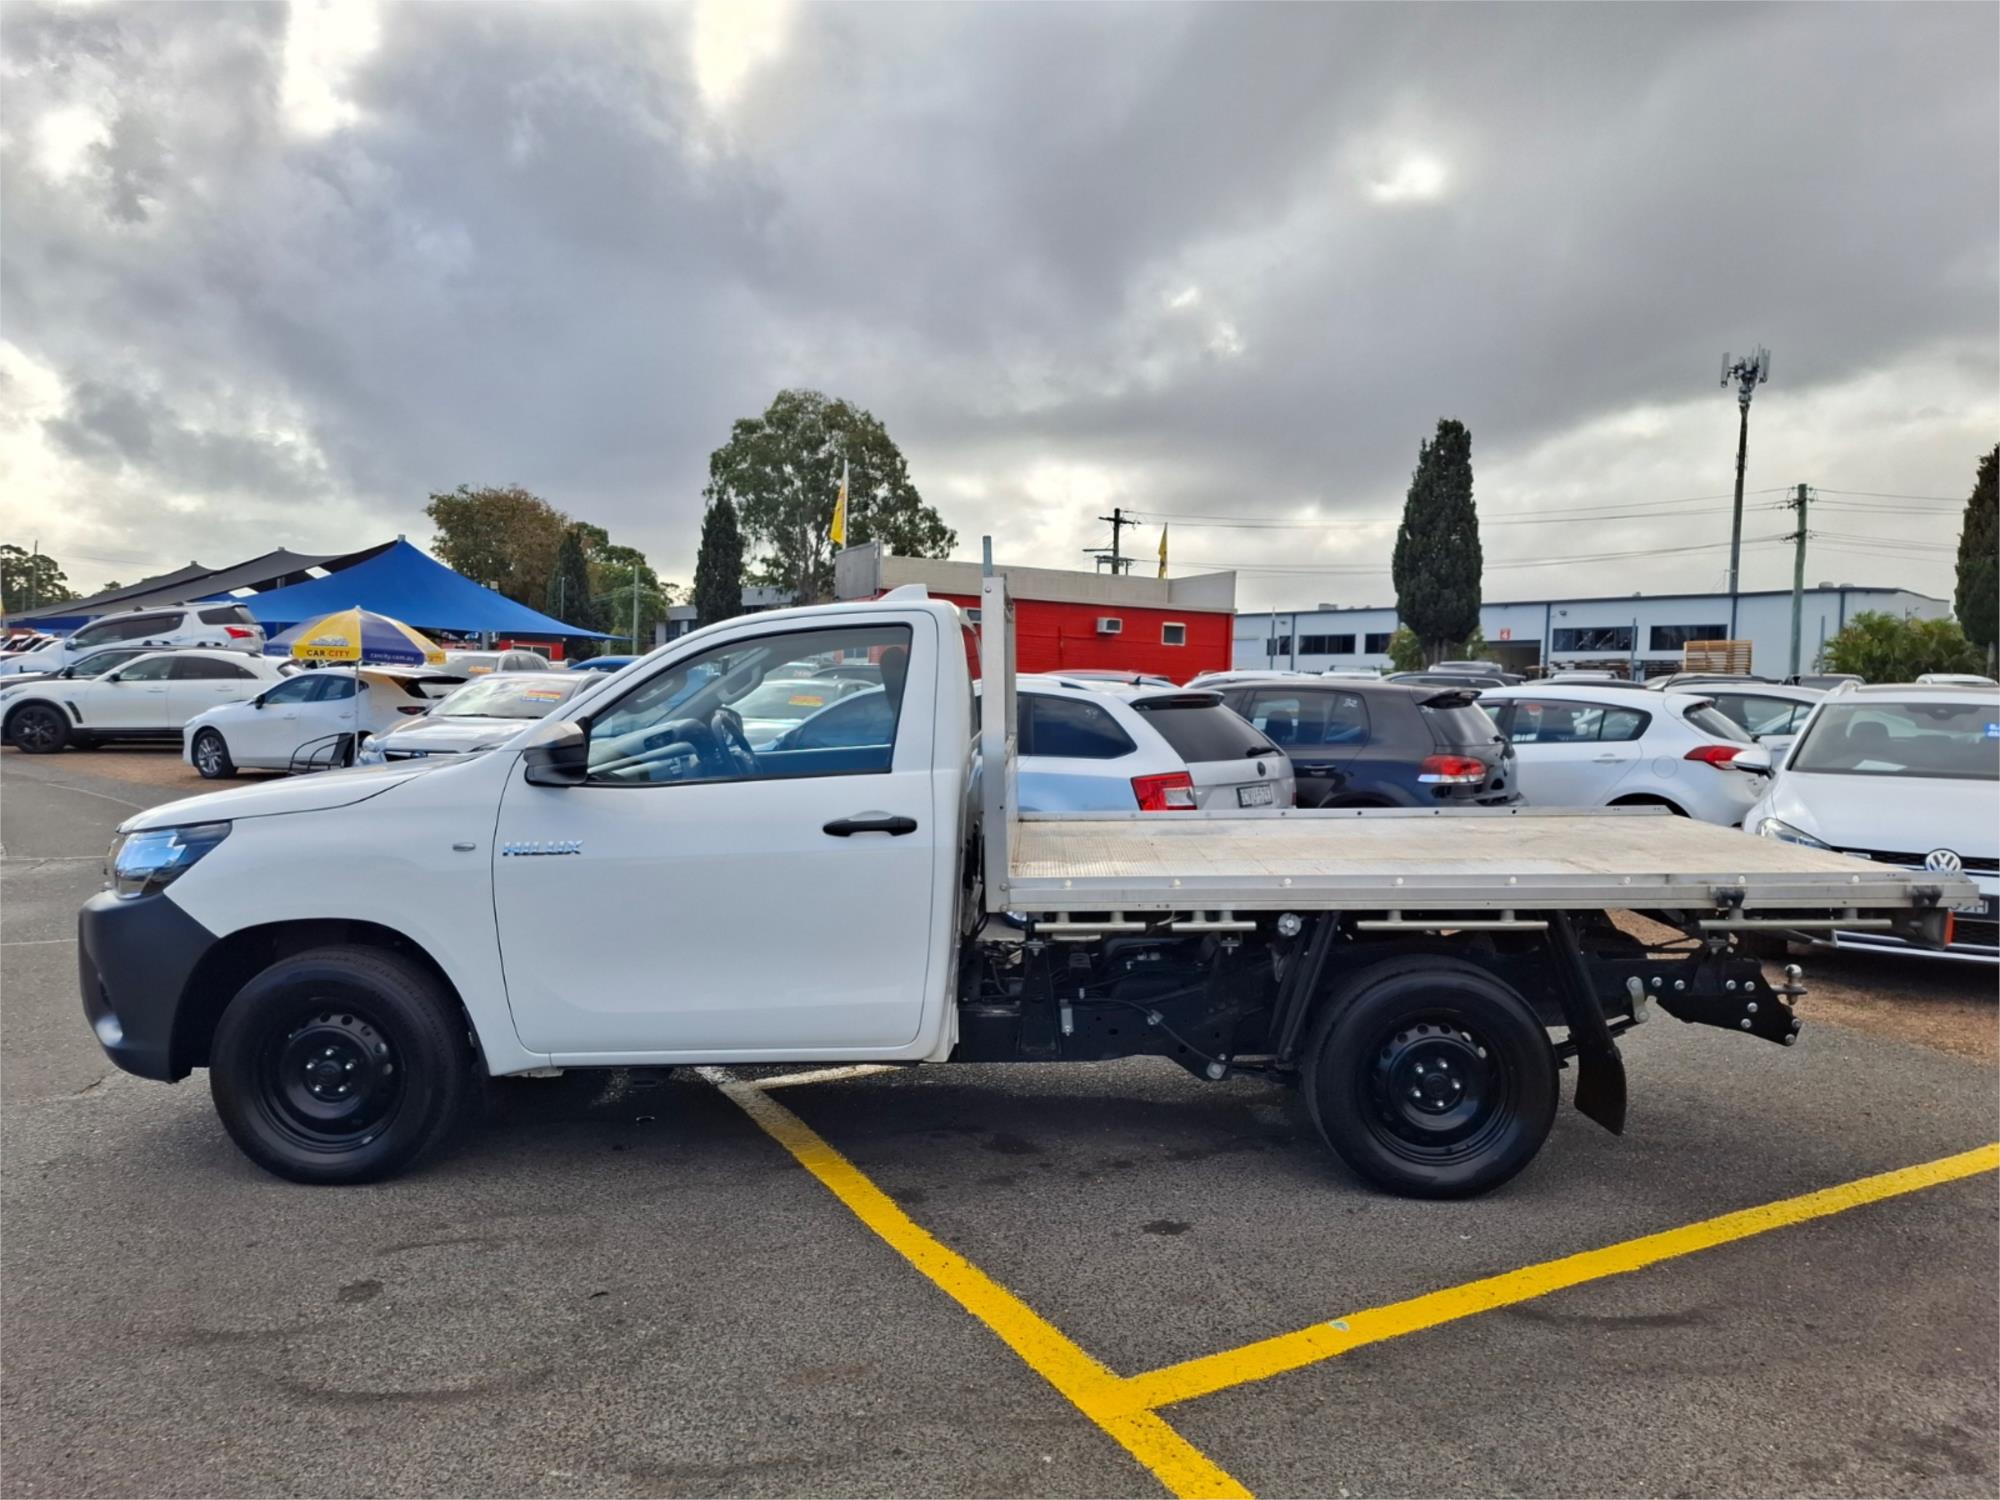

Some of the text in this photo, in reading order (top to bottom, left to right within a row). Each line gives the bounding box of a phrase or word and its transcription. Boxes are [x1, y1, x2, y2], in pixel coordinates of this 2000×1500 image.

[306, 649, 351, 657] CAR CITY
[502, 840, 583, 857] HILUX
